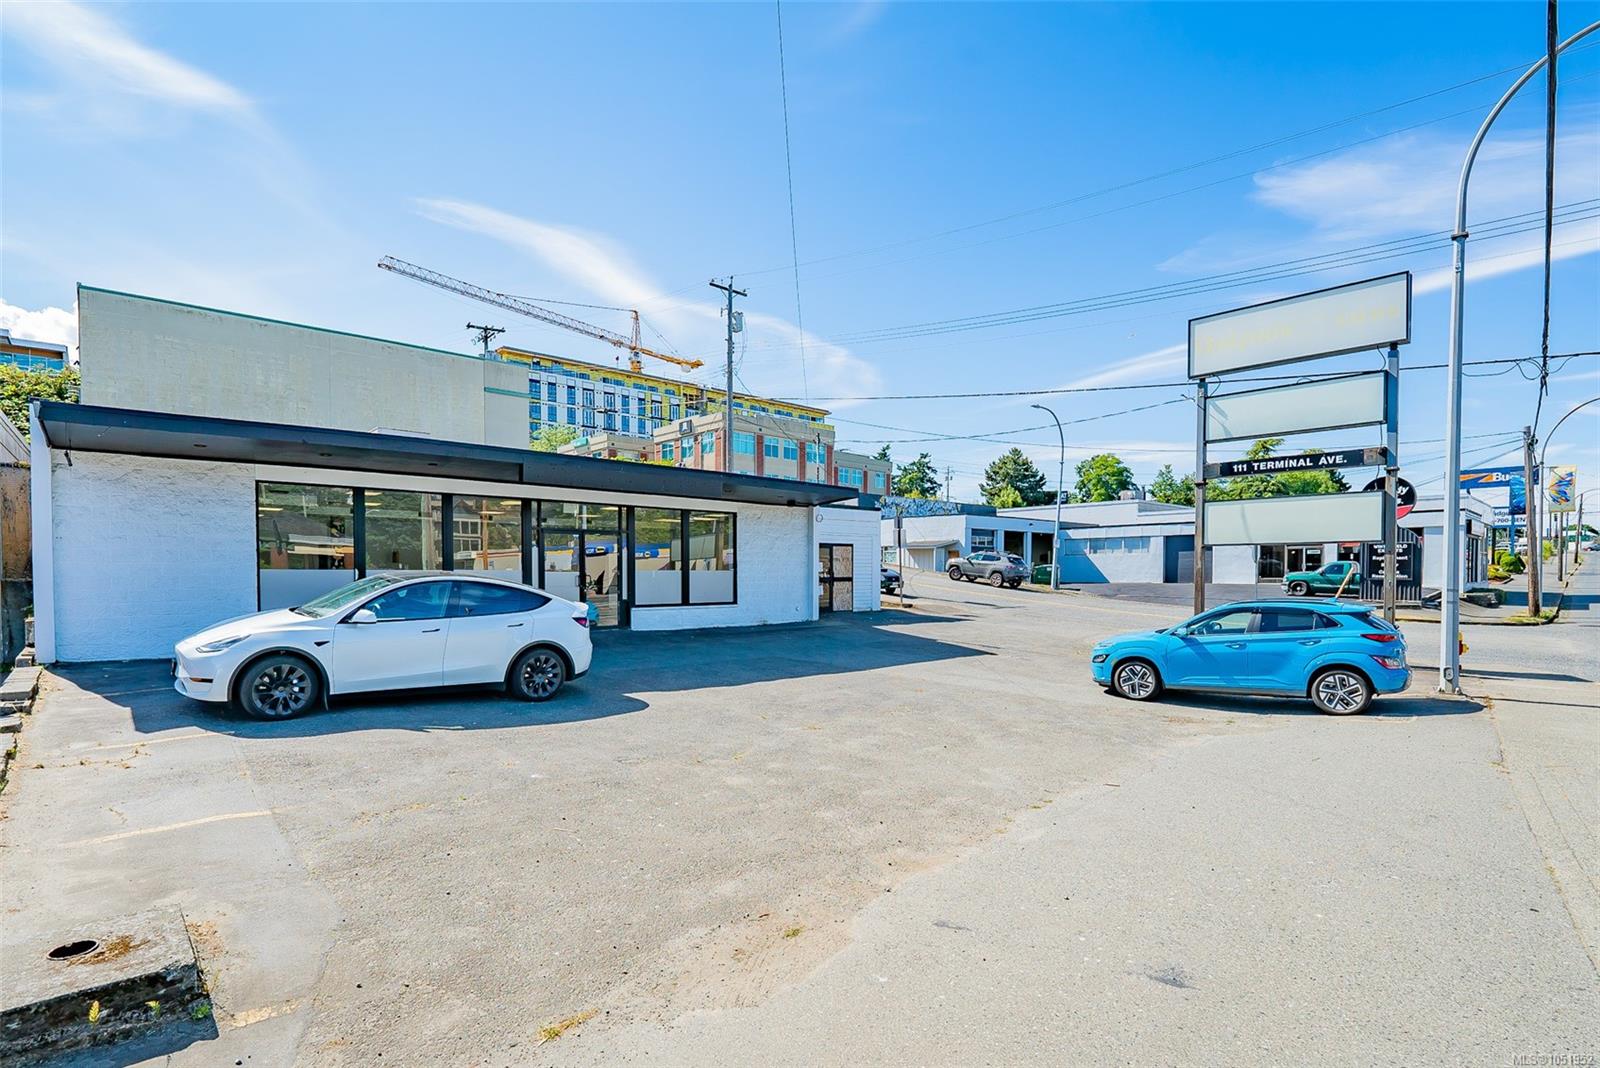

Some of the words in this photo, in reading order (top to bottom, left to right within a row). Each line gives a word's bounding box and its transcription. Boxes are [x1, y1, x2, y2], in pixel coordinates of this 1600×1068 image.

[1232, 463, 1248, 473] 111
[1252, 458, 1313, 471] TERMINAL
[1318, 454, 1348, 466] AVE.
